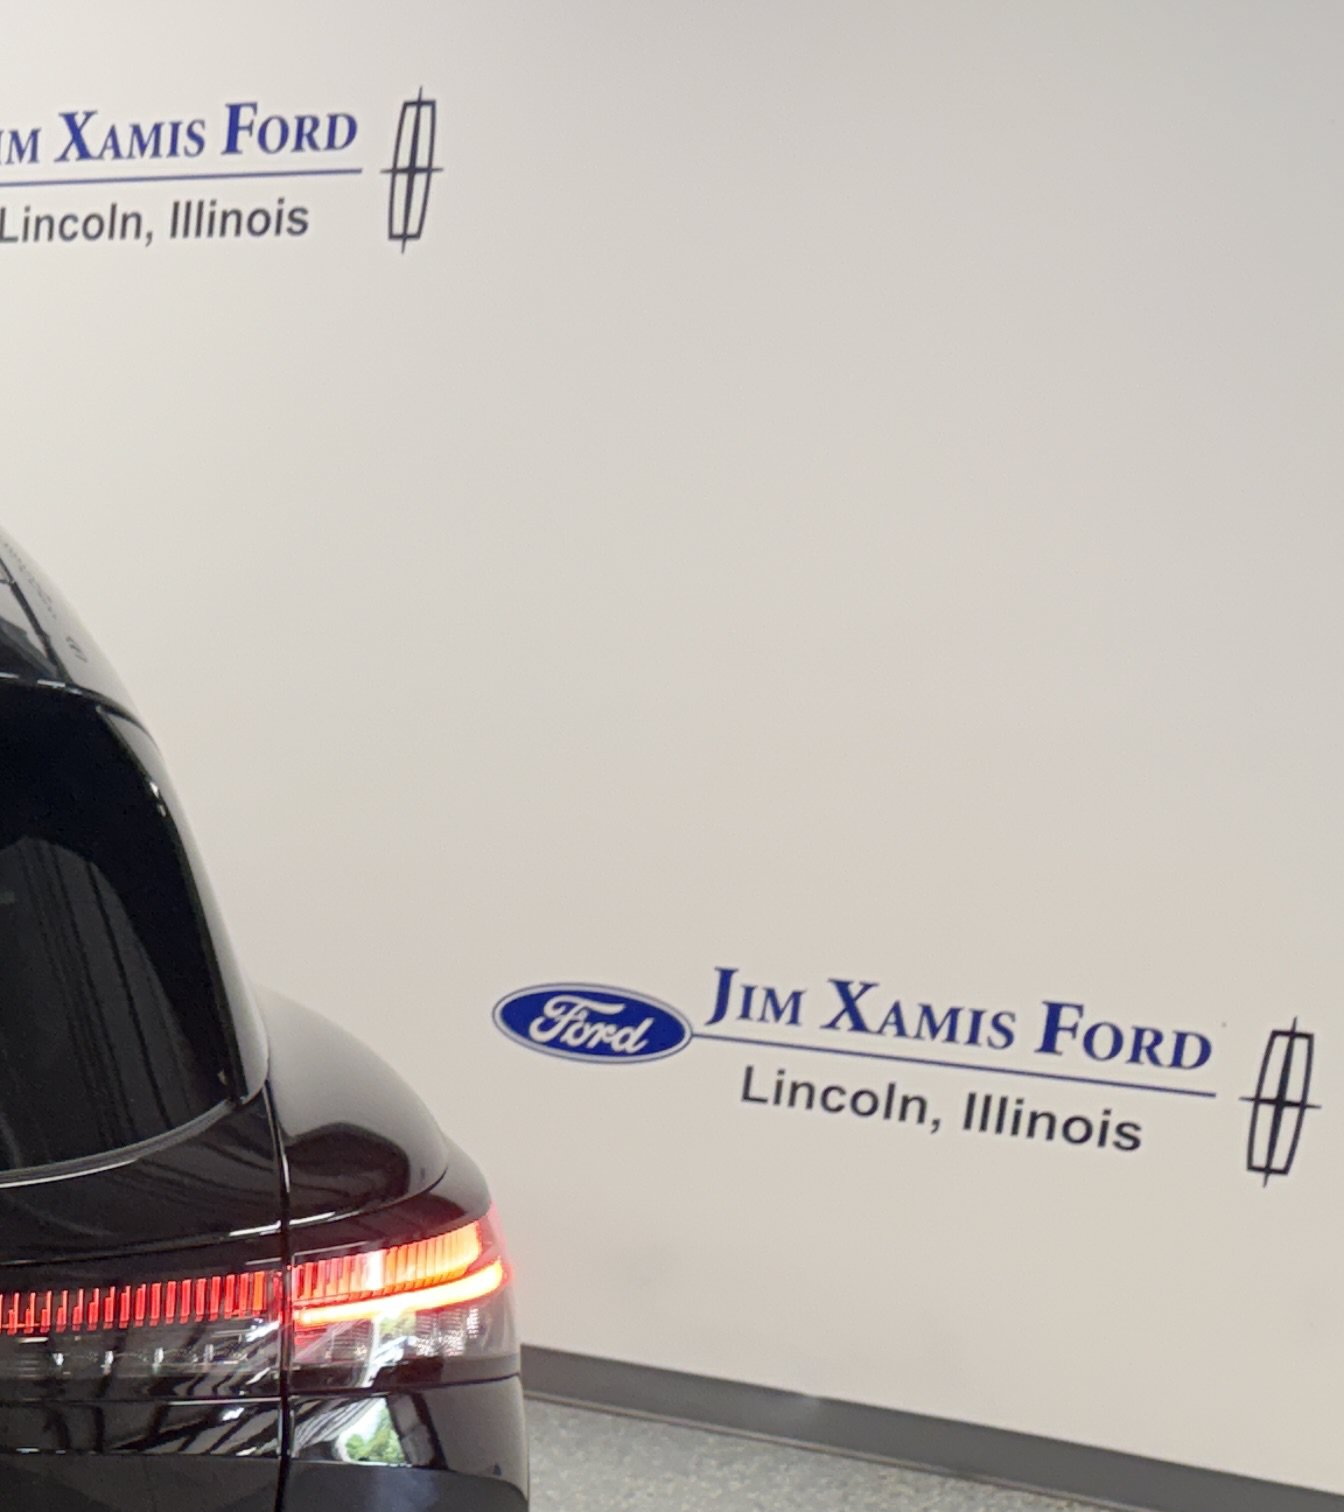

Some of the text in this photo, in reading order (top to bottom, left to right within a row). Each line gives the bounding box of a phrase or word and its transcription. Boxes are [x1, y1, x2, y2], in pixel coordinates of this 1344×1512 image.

[169, 197, 309, 239] Illinois
[528, 995, 652, 1057] Ford
[739, 1065, 1144, 1153] Lincoln, Illinois
